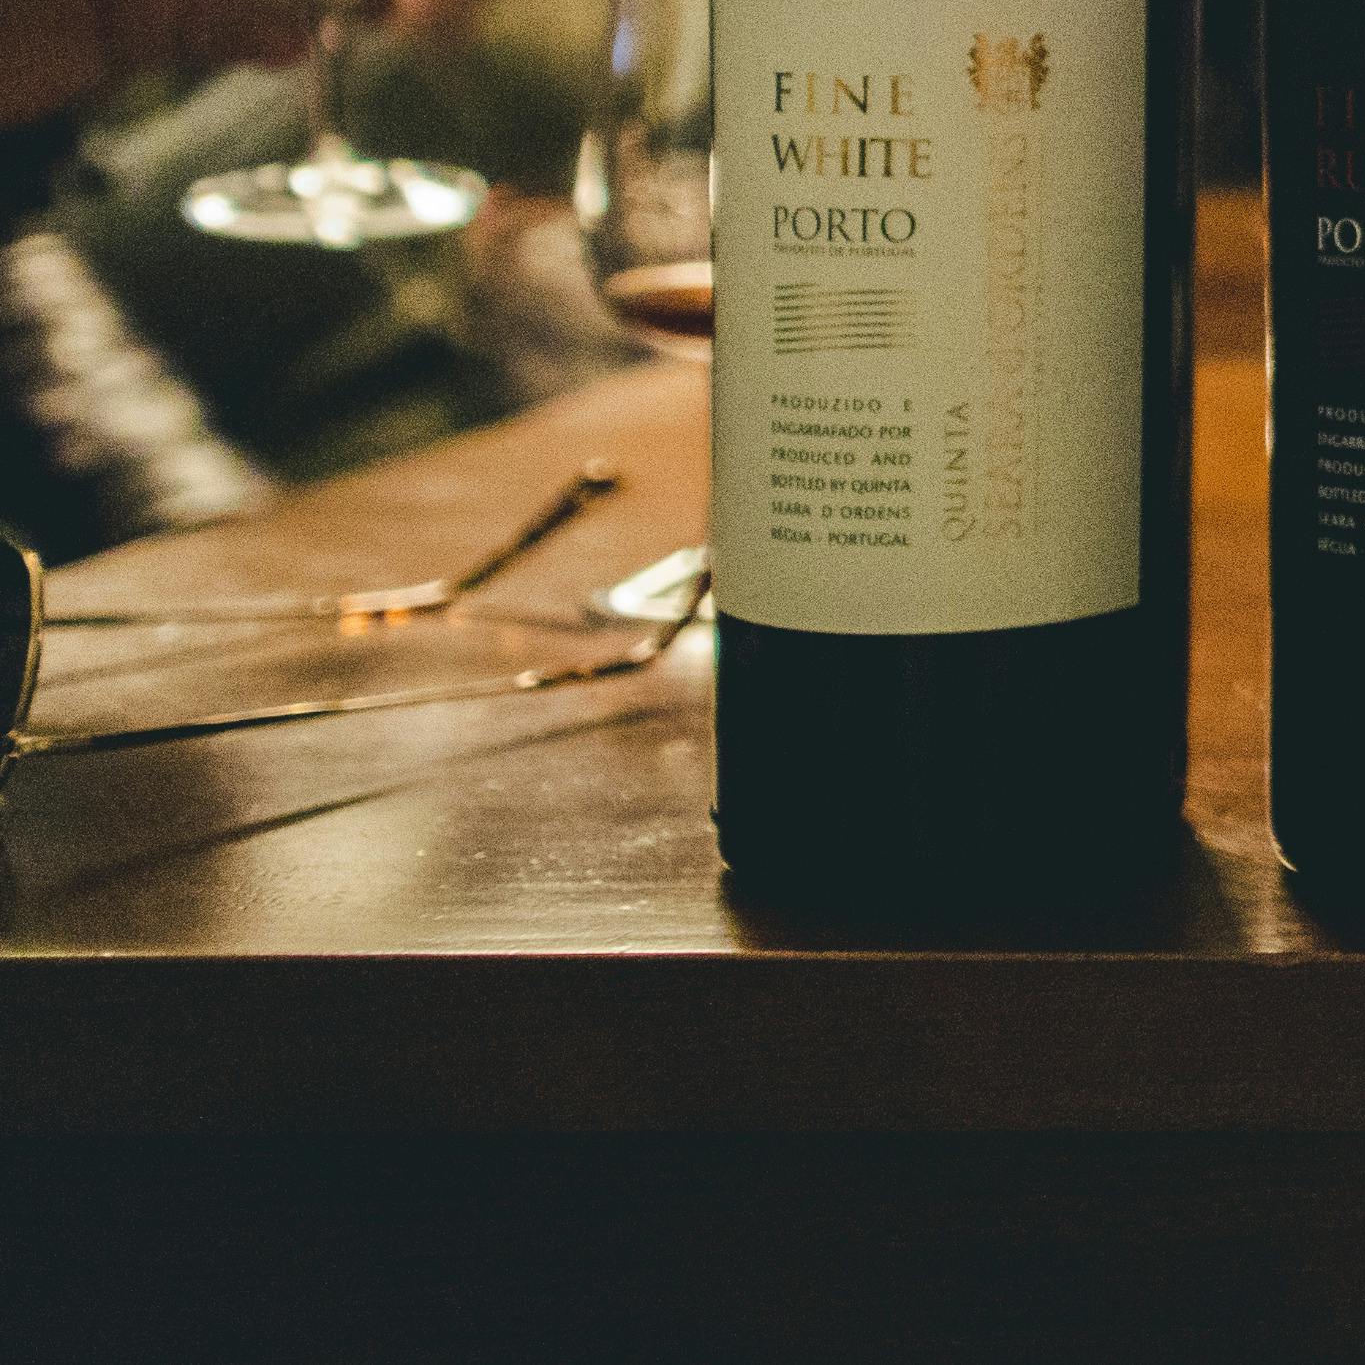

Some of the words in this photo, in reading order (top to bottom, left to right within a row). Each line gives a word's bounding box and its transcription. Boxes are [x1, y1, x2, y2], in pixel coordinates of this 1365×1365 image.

[774, 71, 914, 115] FINE
[771, 134, 933, 179] WHITE
[773, 206, 917, 244] PORTO
[771, 394, 882, 412] PRODUZIDO
[880, 426, 912, 438] POR
[771, 447, 855, 466] PRODUCED
[871, 451, 912, 466] AND
[941, 401, 974, 542] QUINTA
[851, 479, 912, 493] QUINTA
[828, 532, 909, 547] PORTUGAL
